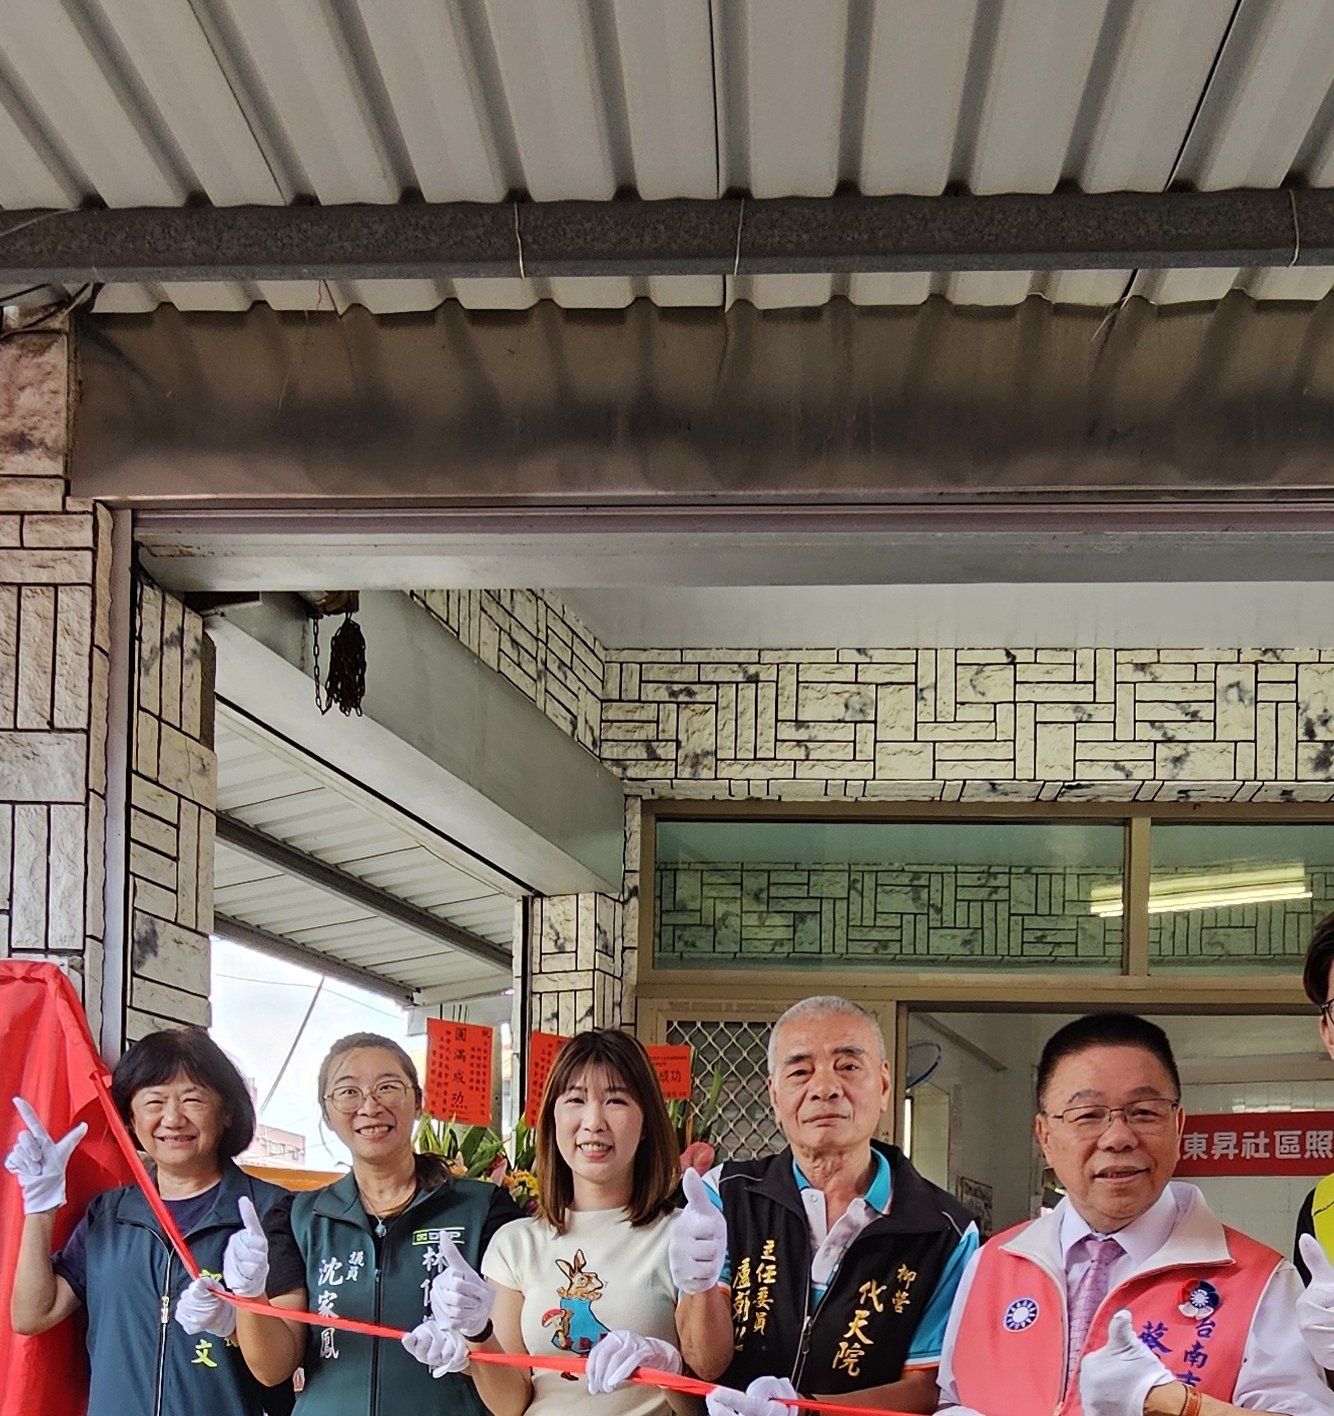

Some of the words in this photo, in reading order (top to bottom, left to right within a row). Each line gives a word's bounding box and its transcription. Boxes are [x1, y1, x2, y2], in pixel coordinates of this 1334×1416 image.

[451, 1027, 467, 1105] 圓滿成功
[753, 1239, 777, 1336] 主任委員
[832, 1279, 888, 1377] 代天院
